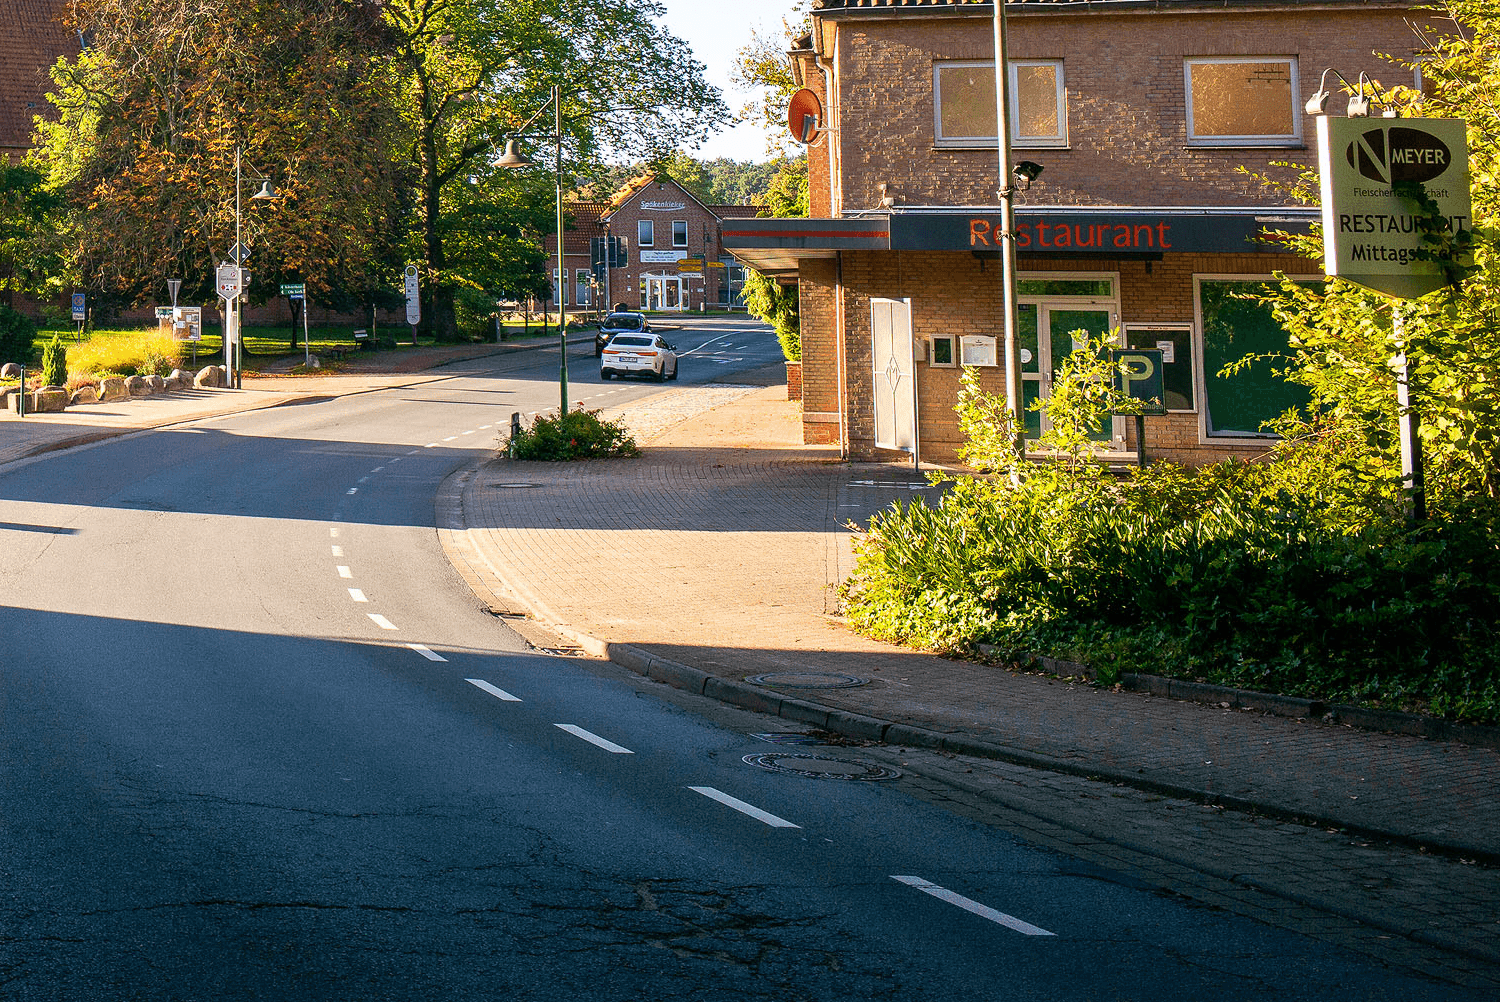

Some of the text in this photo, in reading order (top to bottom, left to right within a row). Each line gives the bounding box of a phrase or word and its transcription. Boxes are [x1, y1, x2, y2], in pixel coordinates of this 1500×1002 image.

[1391, 148, 1446, 165] MEYER
[1339, 214, 1467, 234] RESTAURNT
[1122, 355, 1154, 397] P
